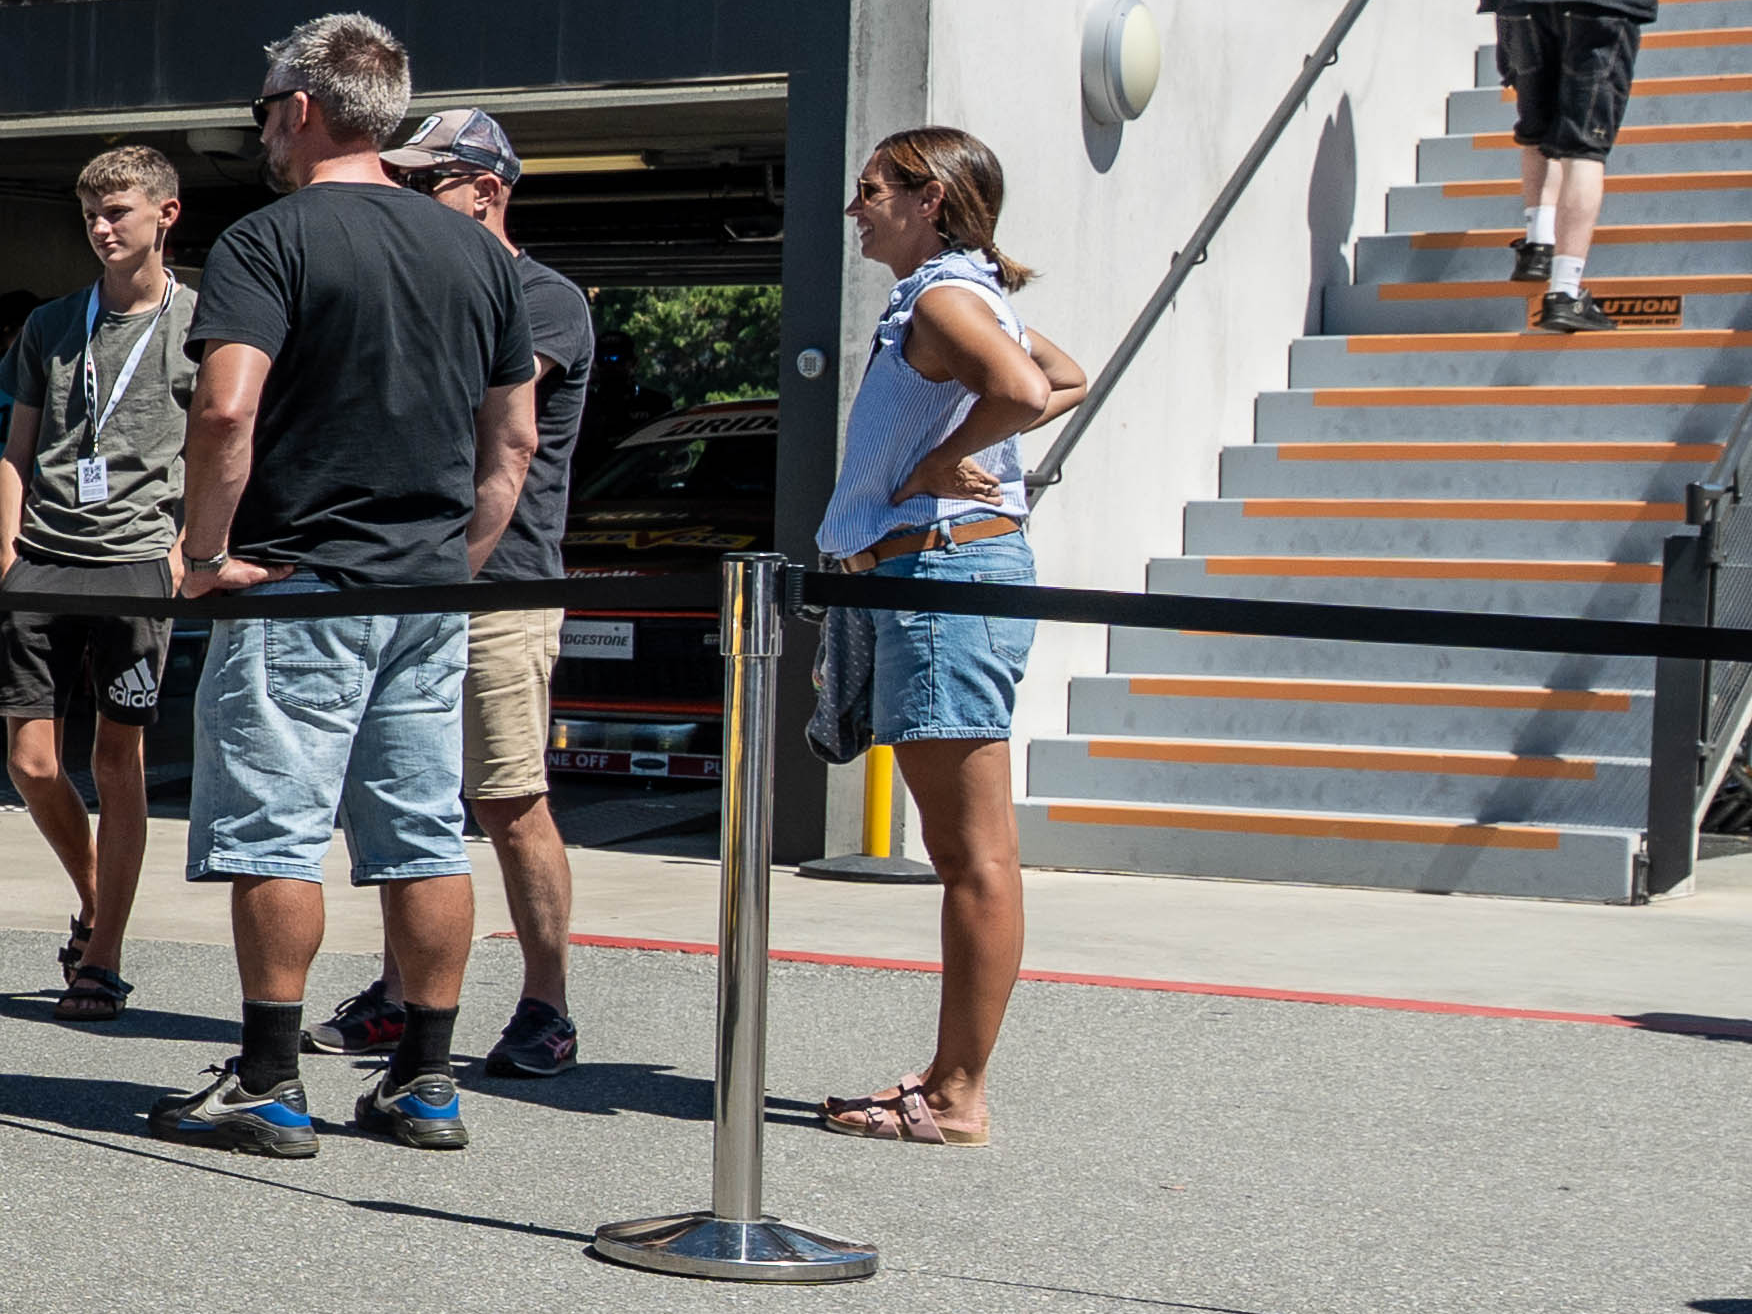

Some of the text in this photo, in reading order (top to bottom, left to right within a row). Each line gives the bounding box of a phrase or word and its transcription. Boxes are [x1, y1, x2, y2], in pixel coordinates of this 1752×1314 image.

[1602, 299, 1678, 314] UTION
[560, 633, 629, 648] IDGESTONE
[108, 685, 157, 708] adida
[578, 754, 609, 768] OFF
